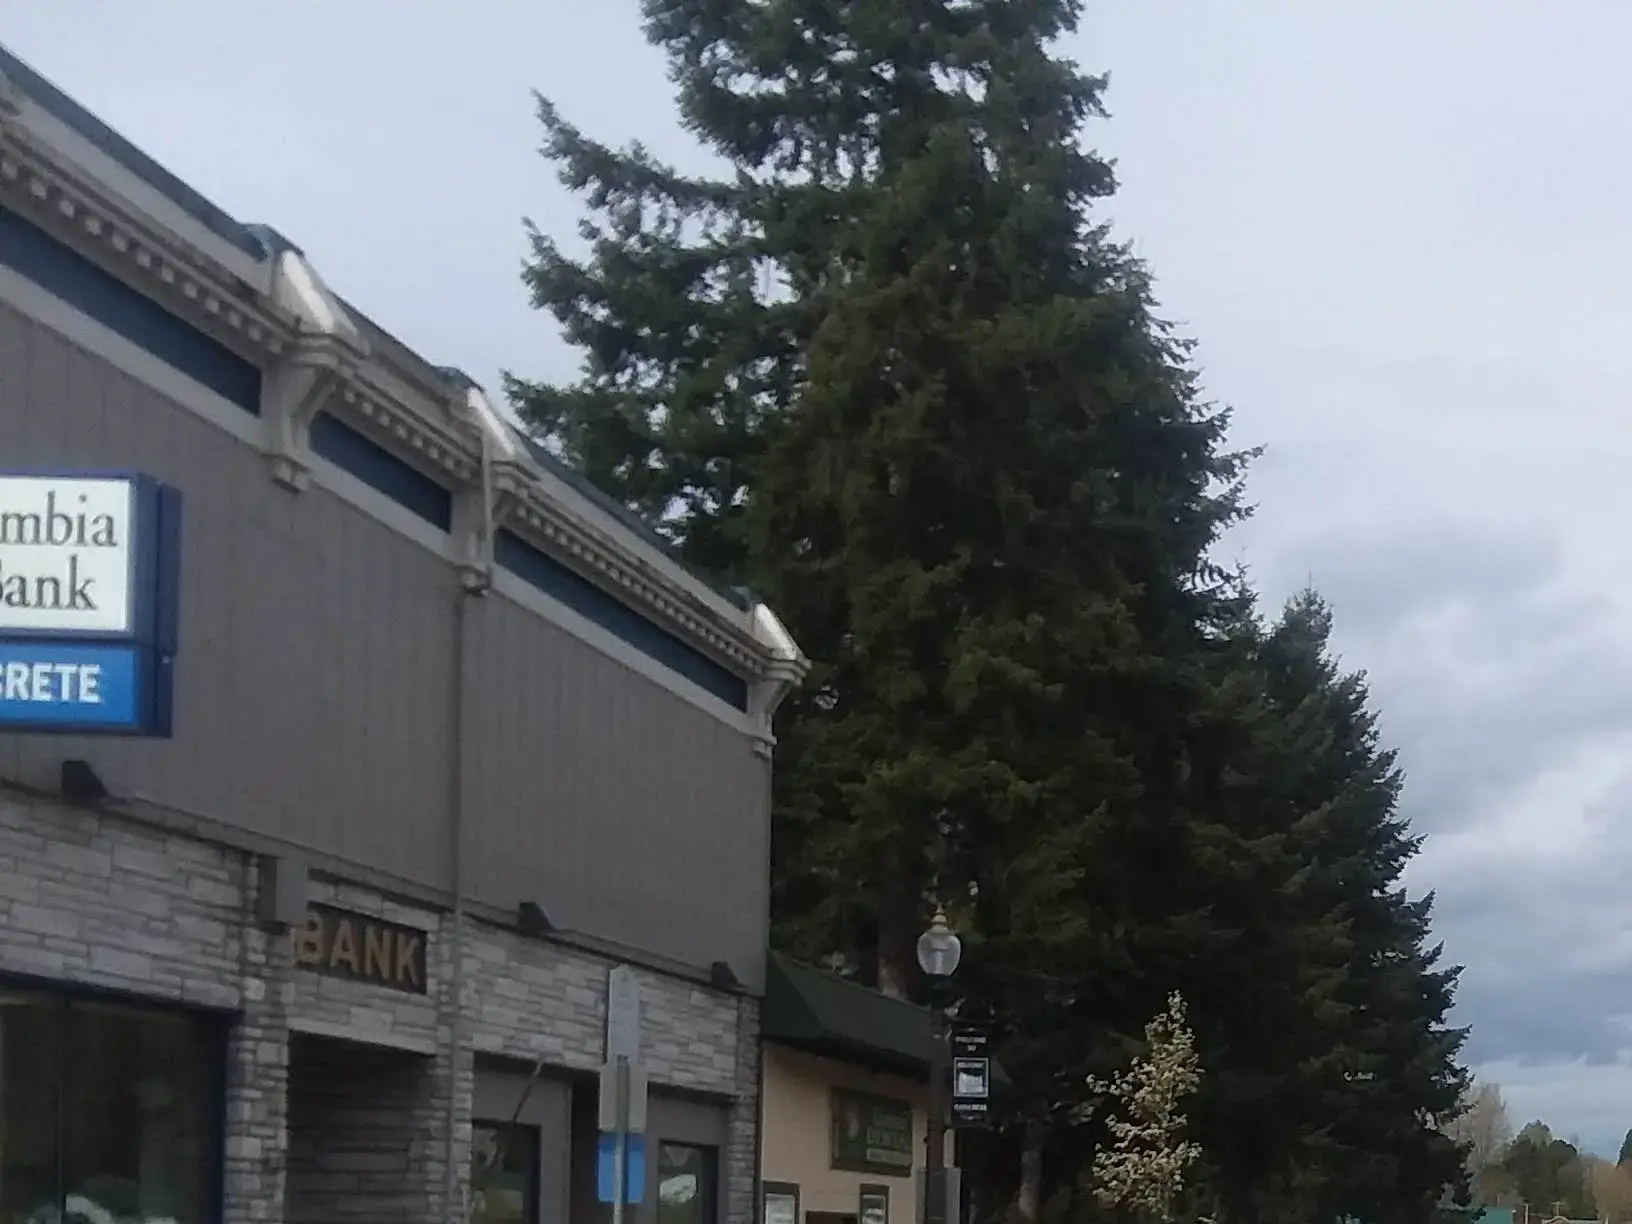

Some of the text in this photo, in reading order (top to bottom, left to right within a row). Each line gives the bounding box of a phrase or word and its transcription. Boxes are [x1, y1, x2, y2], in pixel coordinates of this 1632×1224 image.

[0, 553, 98, 610] ank
[0, 661, 104, 704] RETE
[294, 911, 420, 987] BANK
